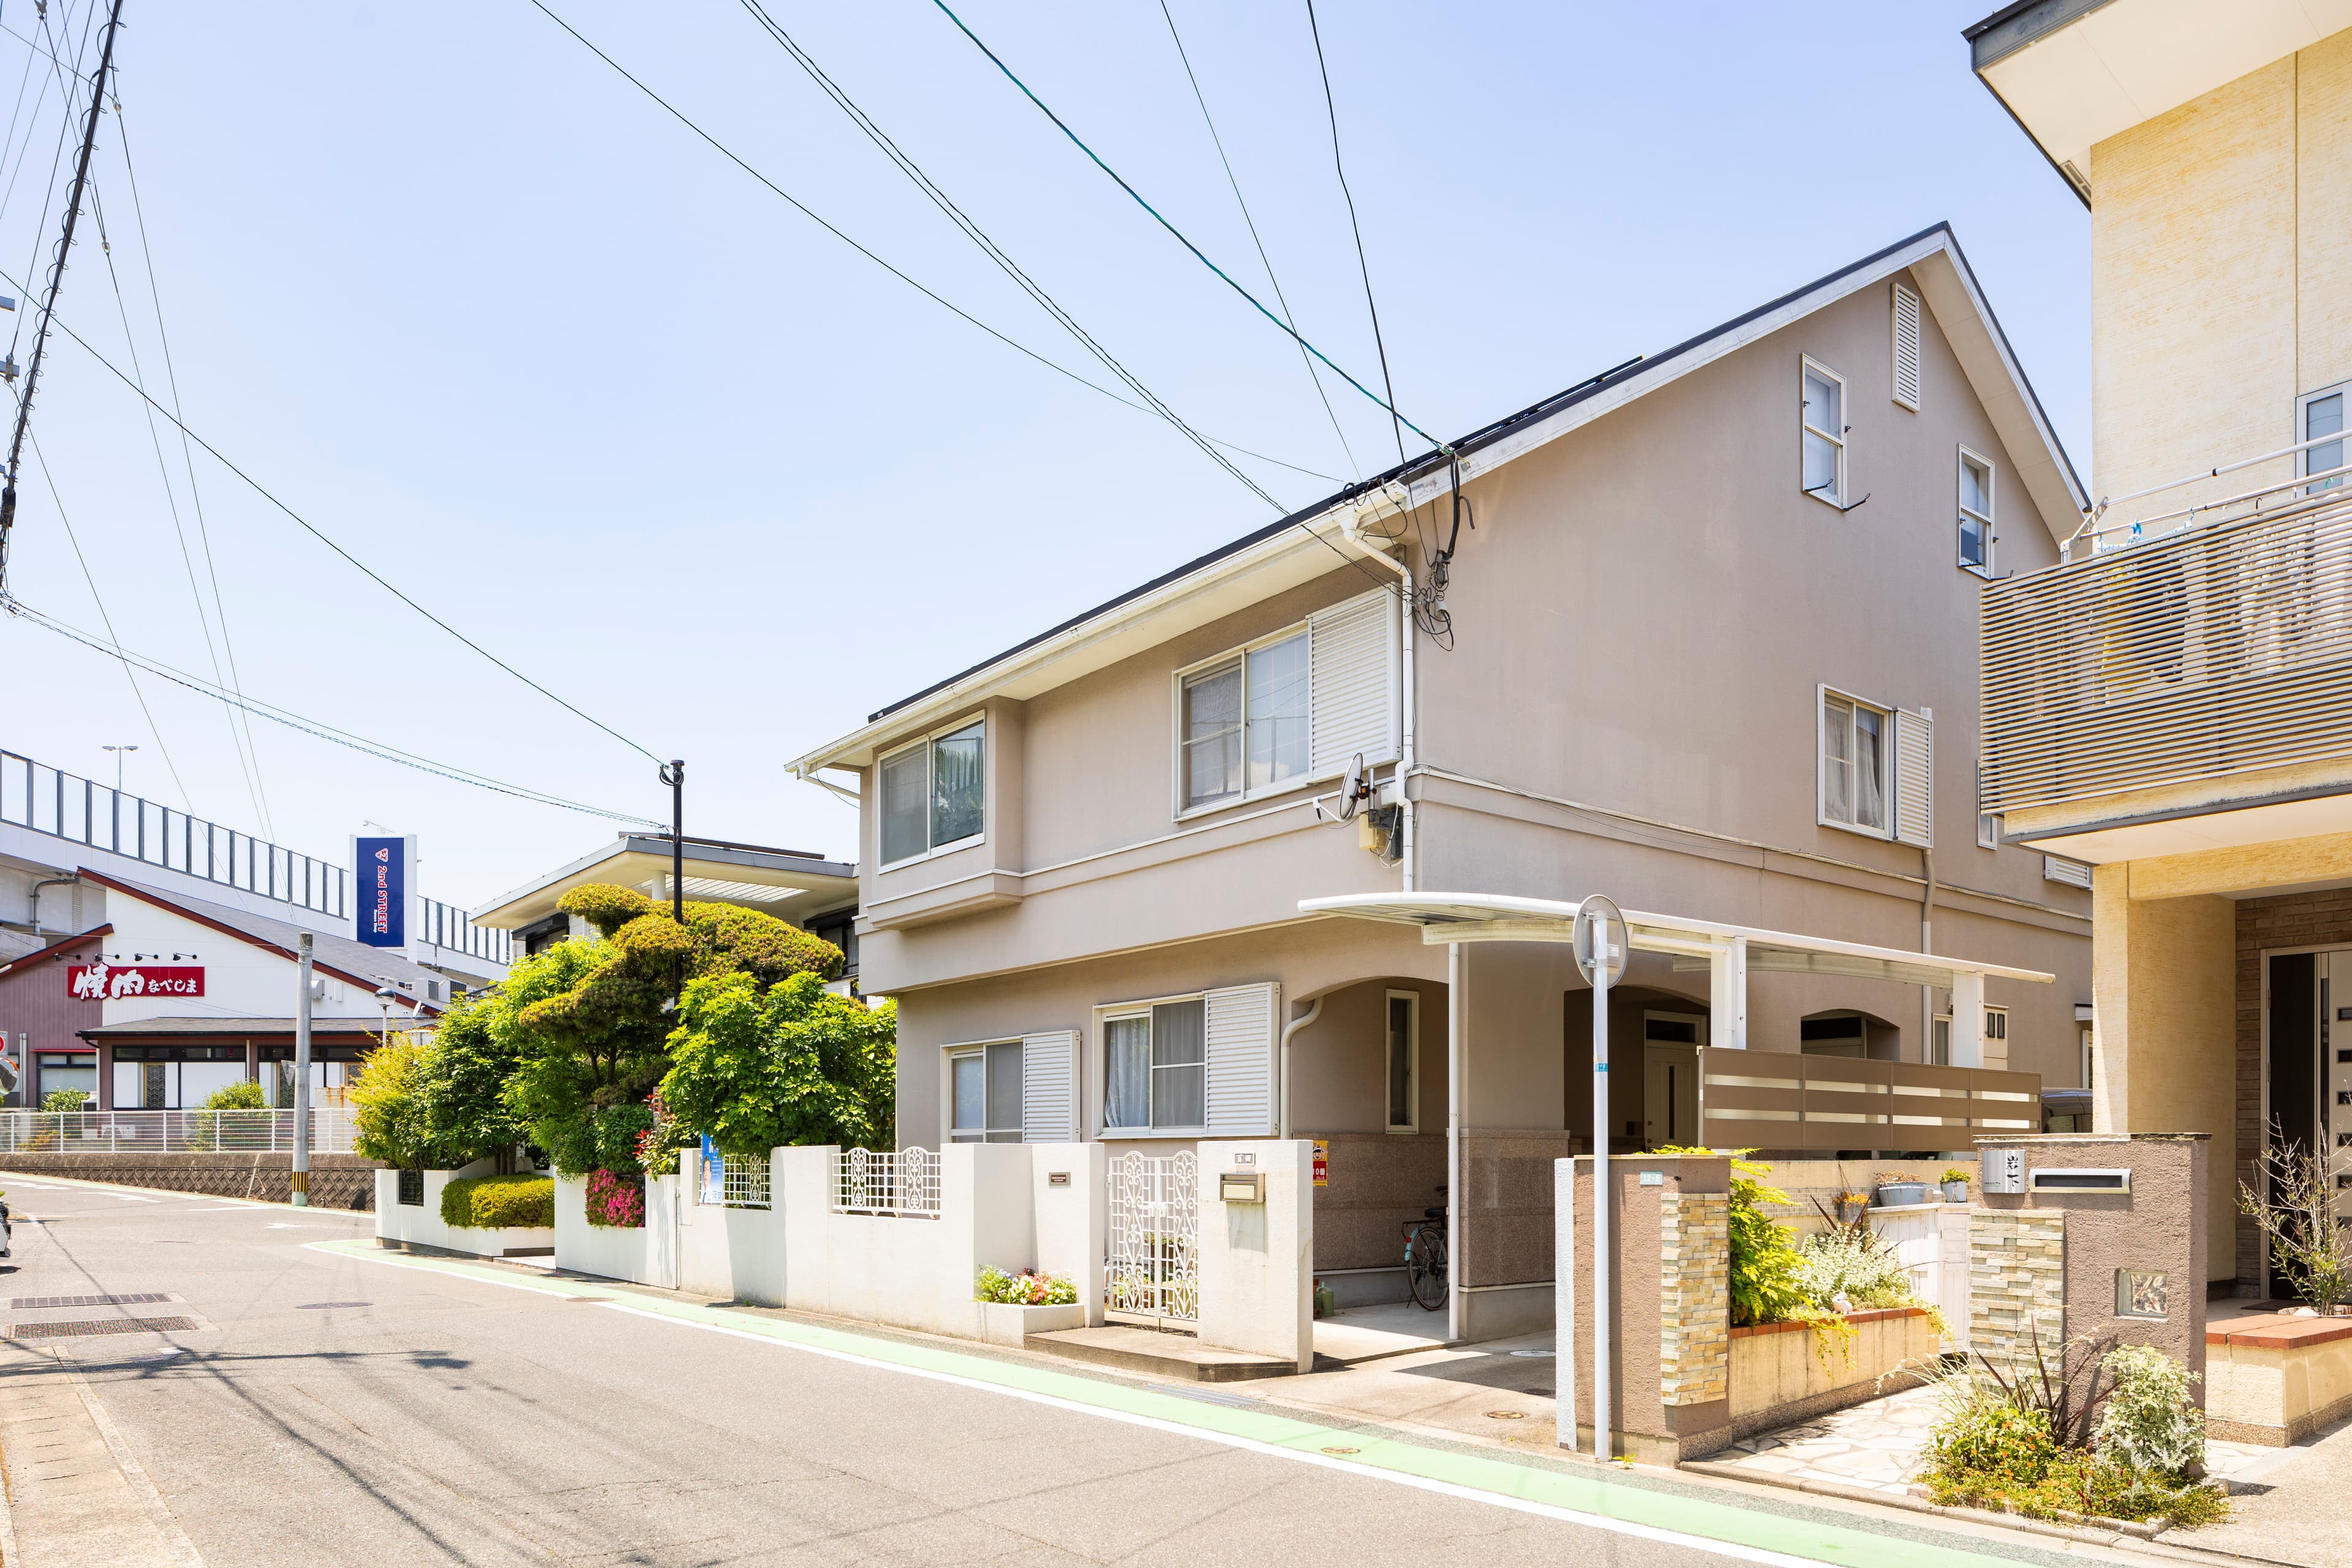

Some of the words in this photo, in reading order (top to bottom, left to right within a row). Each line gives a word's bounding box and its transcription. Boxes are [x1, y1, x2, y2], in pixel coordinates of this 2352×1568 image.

[377, 865, 388, 888] 2nd
[377, 890, 388, 933] STREET
[73, 962, 145, 1000] 焼肉
[148, 978, 197, 993] なべしま
[2005, 1156, 2019, 1187] 岩下
